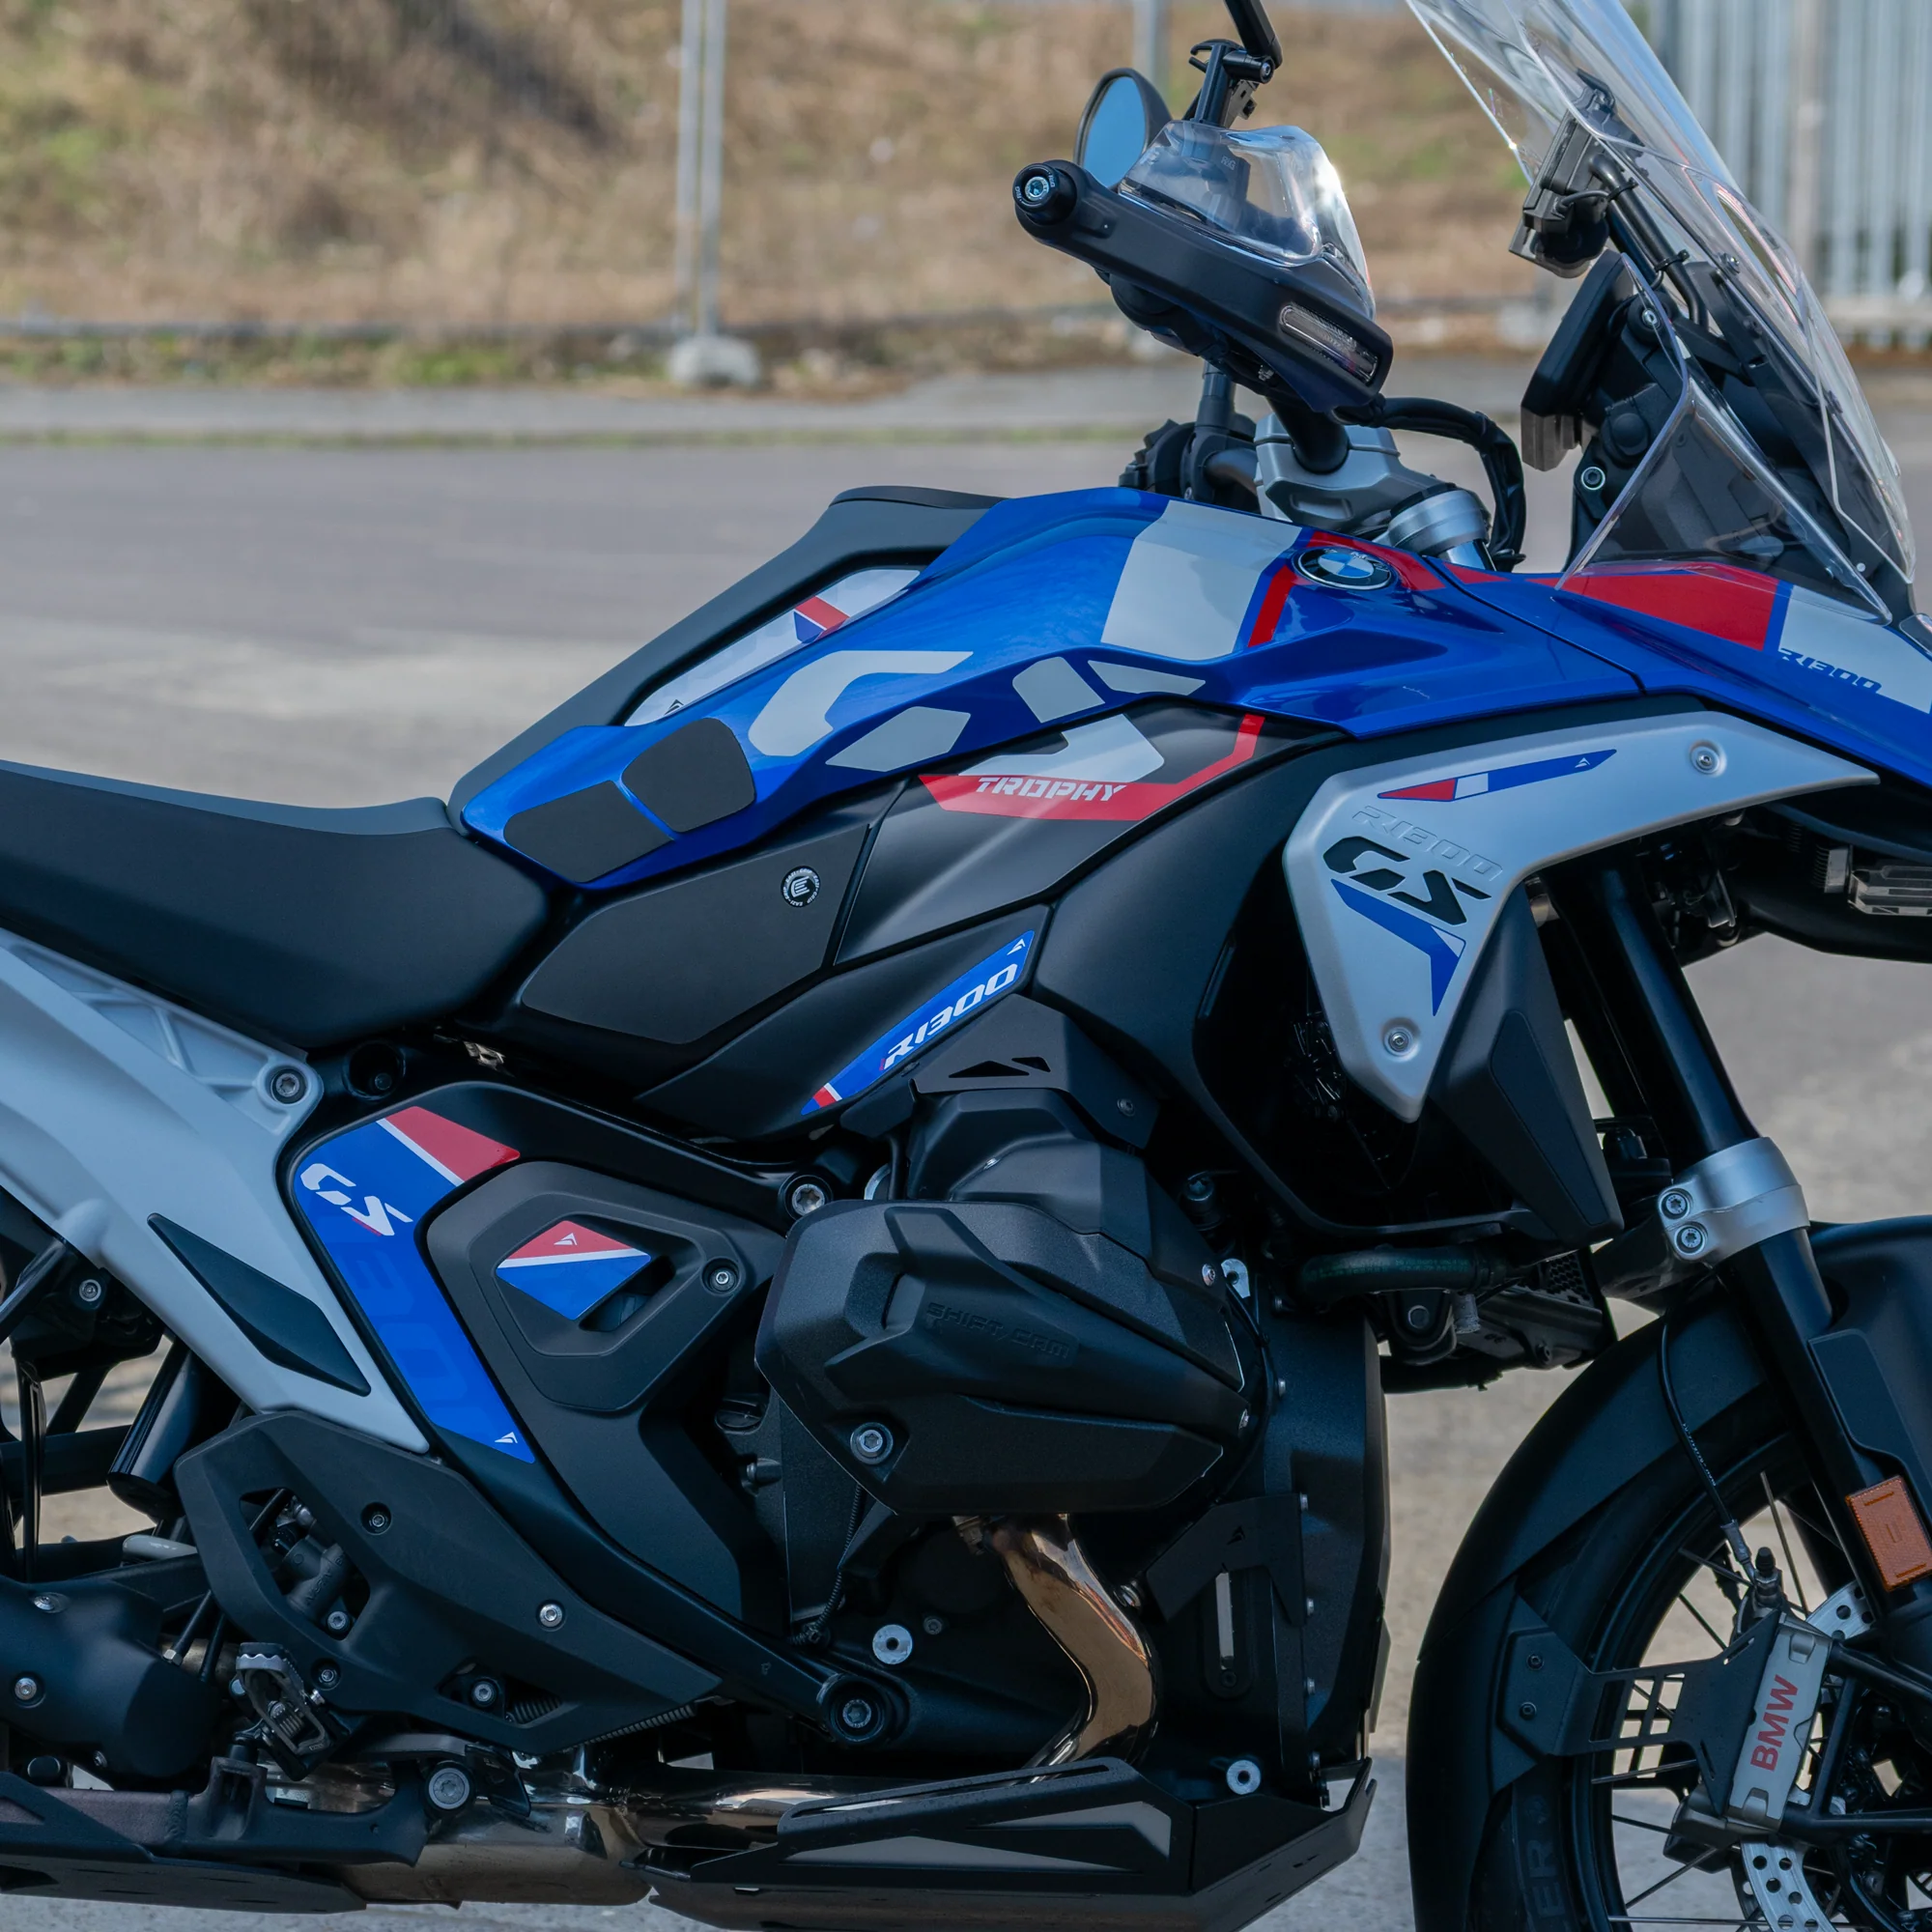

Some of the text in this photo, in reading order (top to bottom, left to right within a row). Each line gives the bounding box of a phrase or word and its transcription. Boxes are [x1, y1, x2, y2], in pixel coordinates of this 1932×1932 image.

[1779, 647, 1883, 694] R1300
[976, 777, 1127, 802] TROPHY
[1322, 836, 1492, 926] GS
[1351, 805, 1504, 882] R1300
[883, 963, 1018, 1069] R1300
[299, 1162, 414, 1236] GS
[1749, 1673, 1800, 1773] BMW
